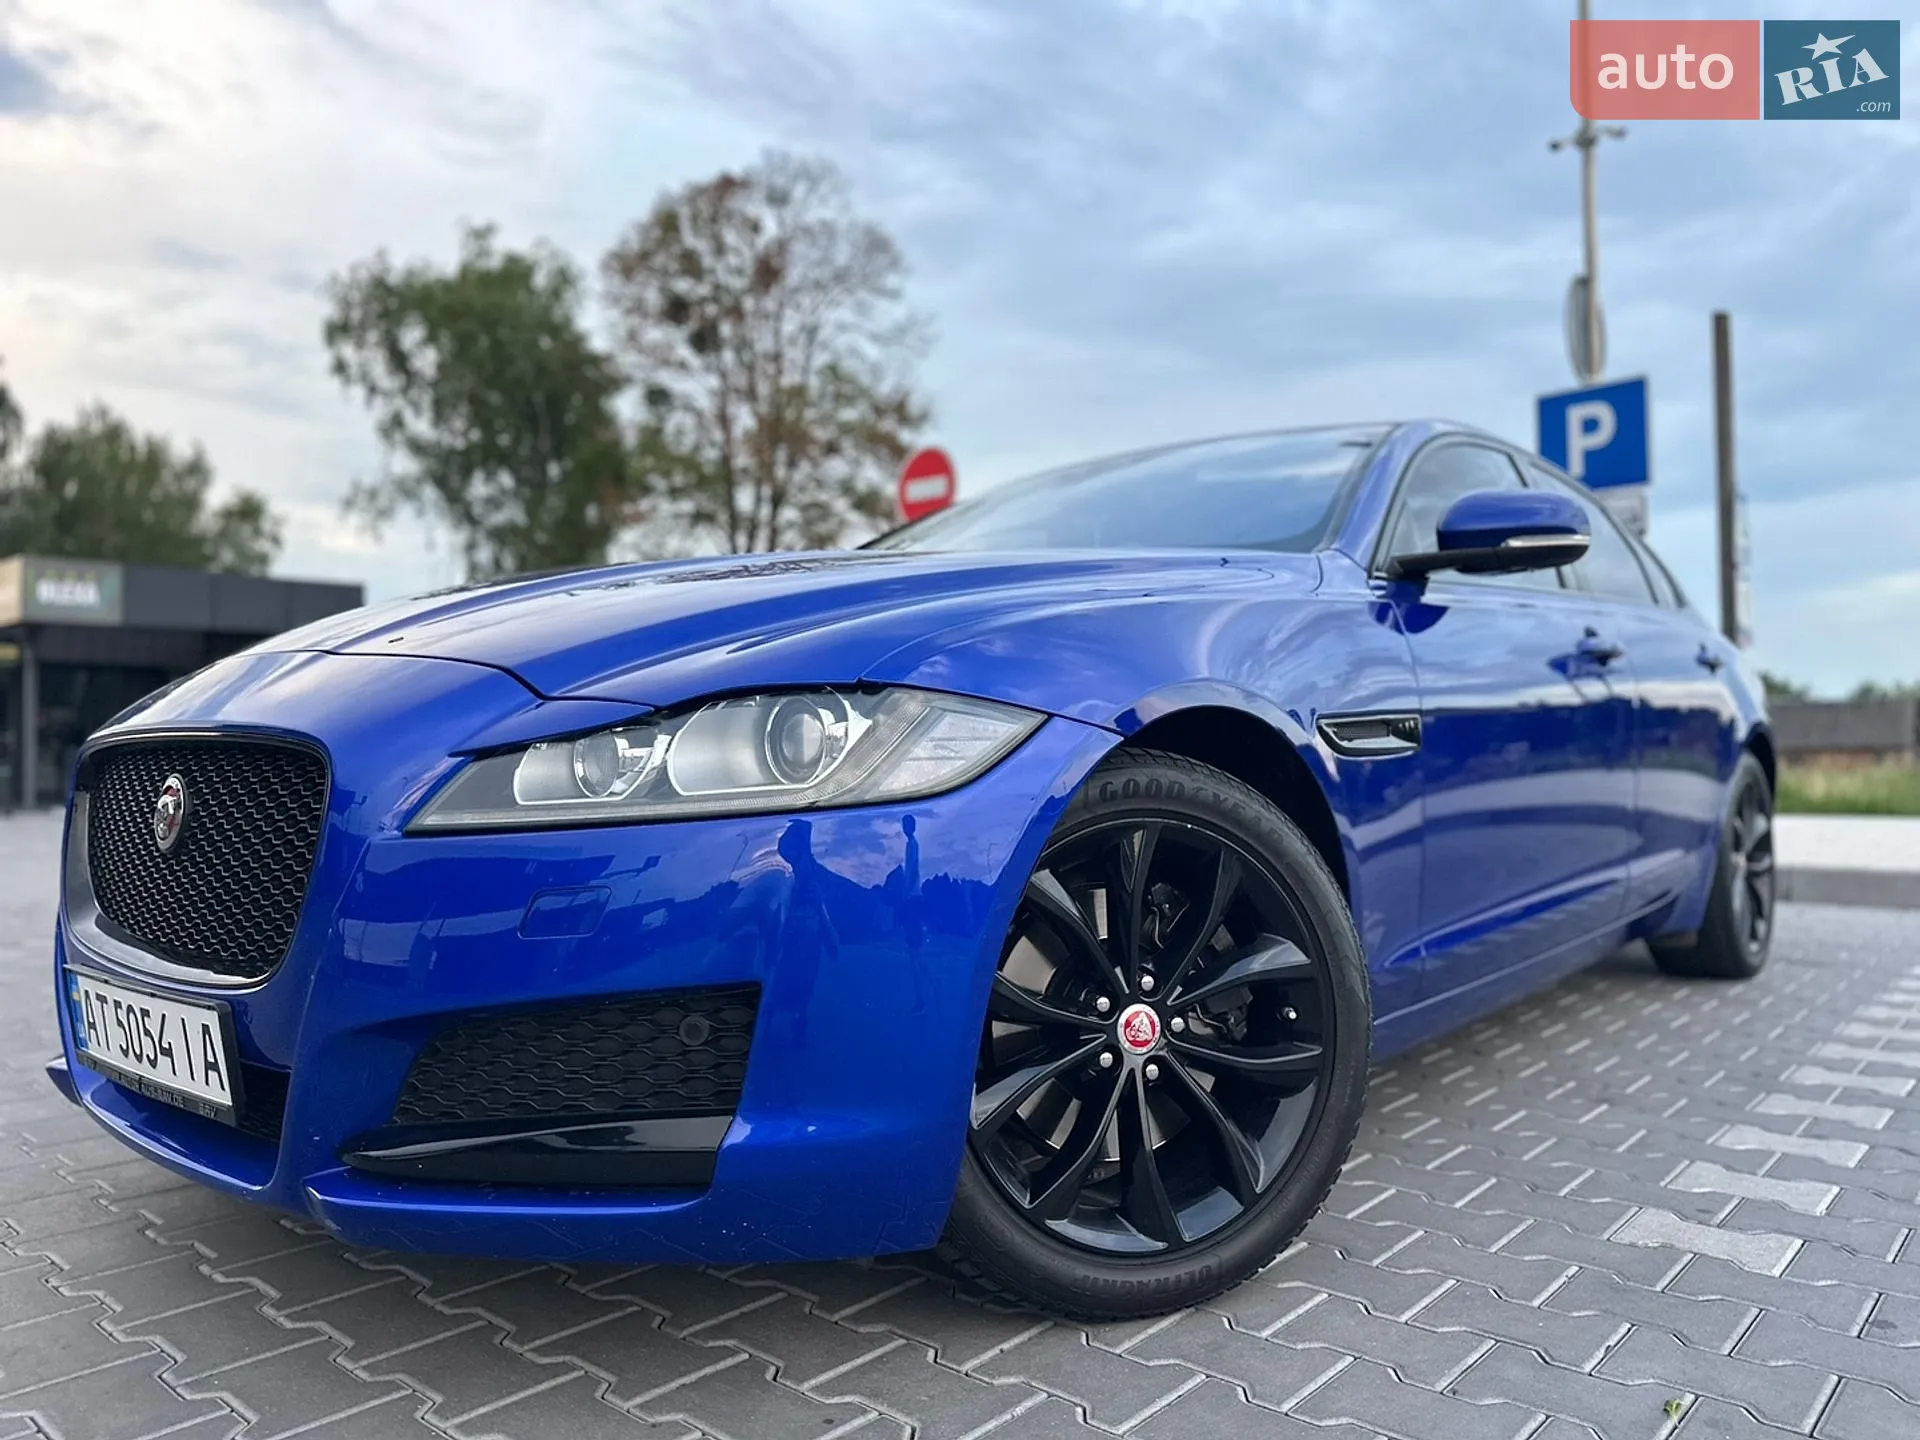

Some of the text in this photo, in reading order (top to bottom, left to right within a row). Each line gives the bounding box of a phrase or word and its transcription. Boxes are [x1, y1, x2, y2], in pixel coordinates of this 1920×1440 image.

[1565, 399, 1618, 480] P
[84, 989, 111, 1052] AT
[113, 999, 177, 1077] 5054
[181, 1016, 226, 1092] IA
